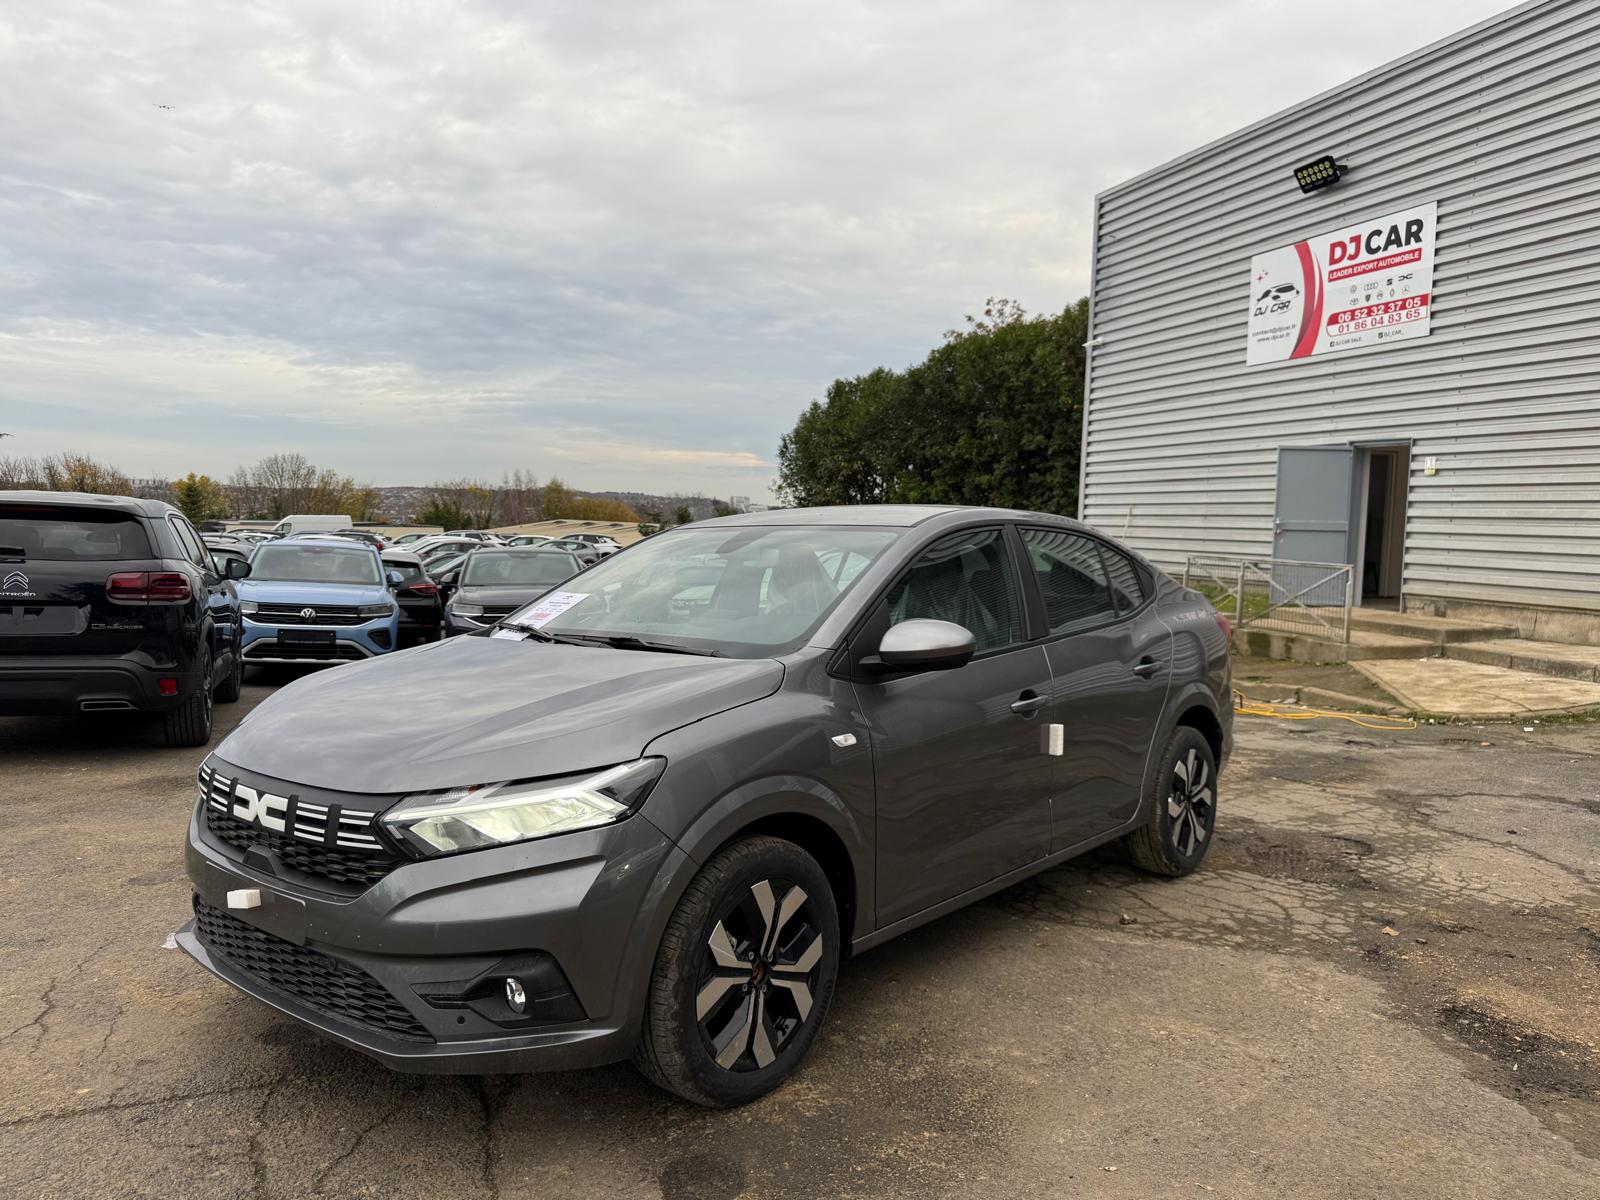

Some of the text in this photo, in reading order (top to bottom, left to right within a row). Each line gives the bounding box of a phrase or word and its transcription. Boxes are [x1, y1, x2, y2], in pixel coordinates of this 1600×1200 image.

[1329, 218, 1424, 266] DJ CAR
[1329, 251, 1420, 279] LEADER EXPORT AUTOMOBILE
[1338, 297, 1421, 323] 06 52 32 37 05
[1338, 308, 1421, 333] 01 86 04 83 65
